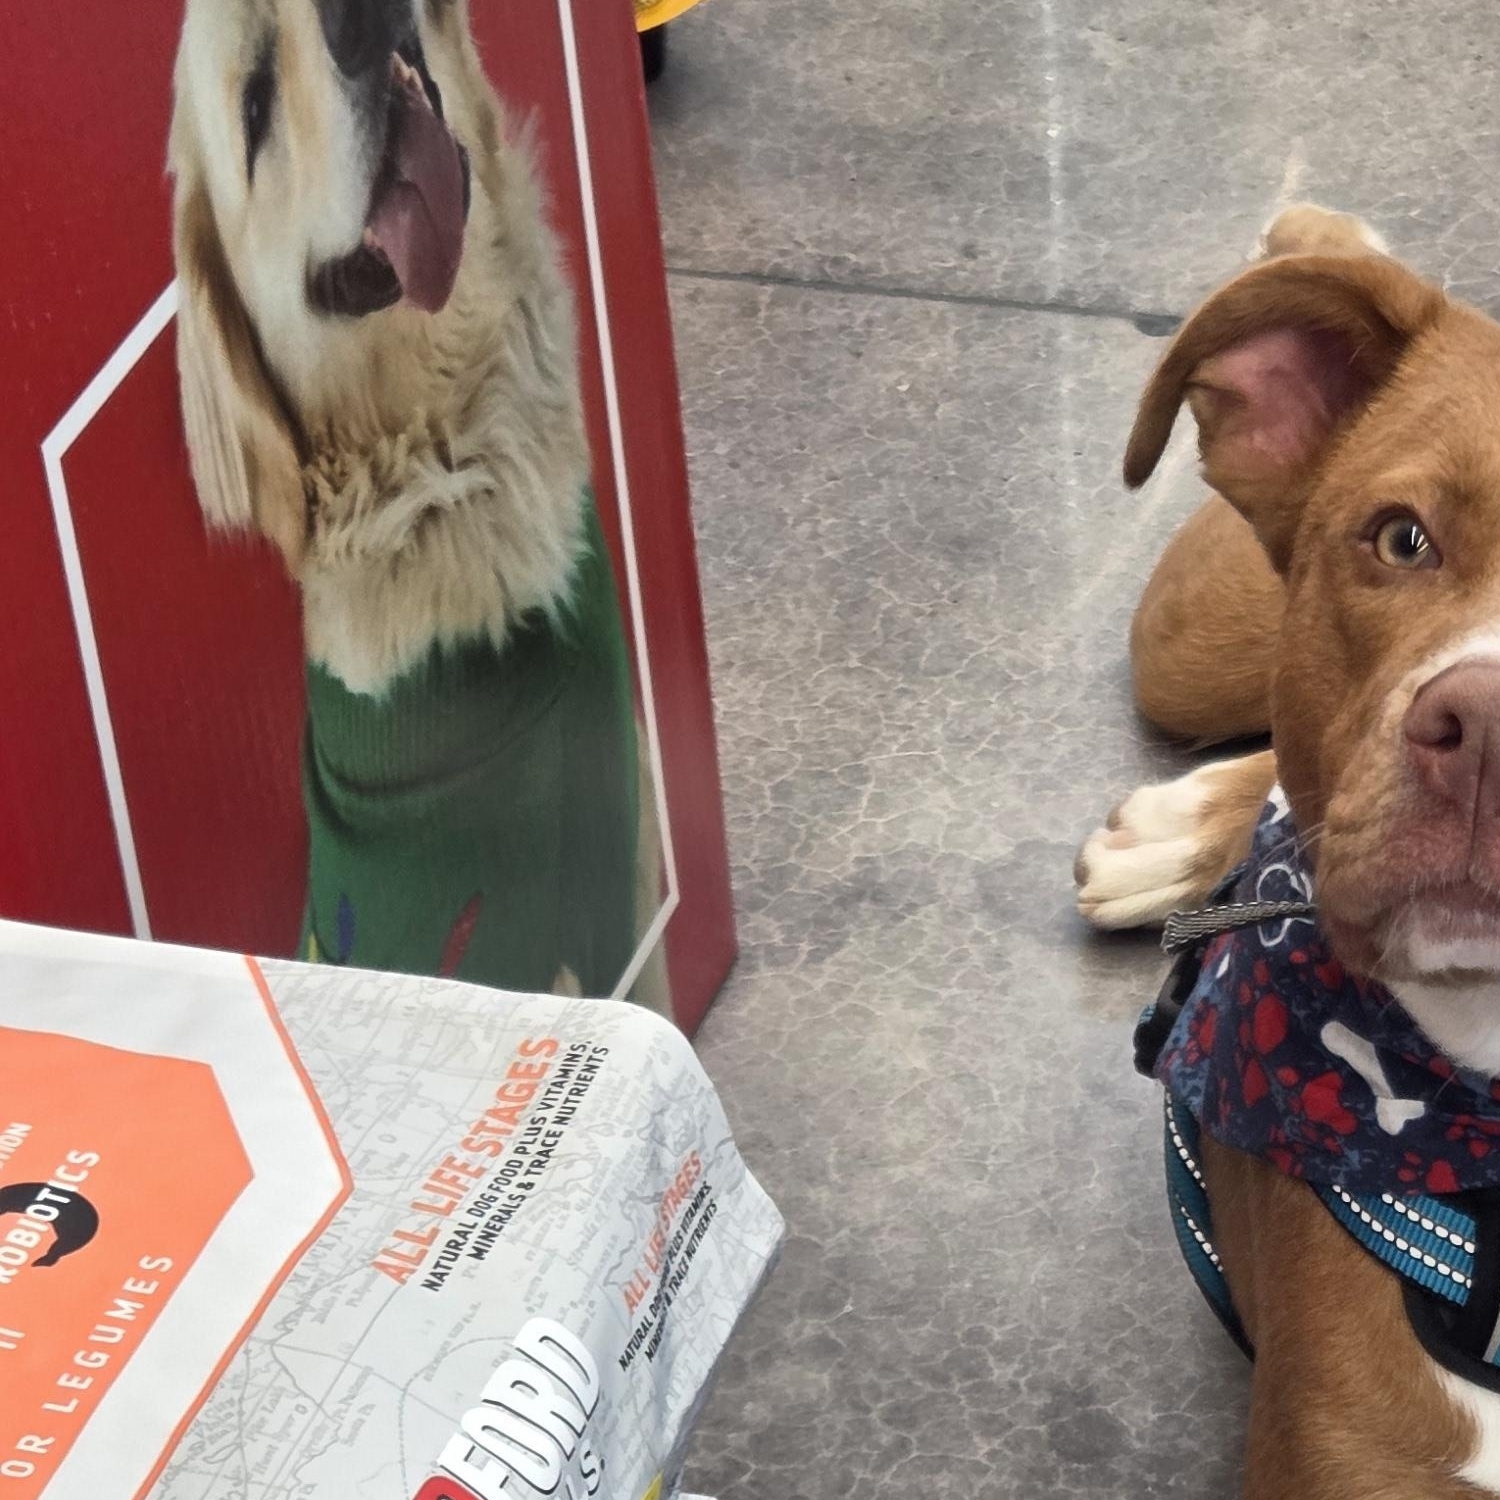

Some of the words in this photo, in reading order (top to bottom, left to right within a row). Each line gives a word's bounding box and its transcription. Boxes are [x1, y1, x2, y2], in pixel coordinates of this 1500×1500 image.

[552, 1046, 609, 1126] NUTRIENTS
[370, 1224, 441, 1286] ALL
[410, 1153, 487, 1217] LIFE
[459, 1036, 560, 1159] STAGES
[421, 1221, 477, 1291] NATURAL
[467, 1192, 498, 1218] DOG
[488, 1158, 524, 1194] FOOD
[513, 1116, 547, 1155] PLUS
[536, 1041, 592, 1114] VITAMINS,
[525, 1129, 564, 1177] TRACE
[516, 1181, 536, 1191] &
[467, 1193, 526, 1261] MINERALS
[687, 1199, 718, 1260] NUTRIENTS
[623, 1268, 651, 1317] ALL
[0, 1434, 56, 1478] OR
[42, 1254, 174, 1413] LEGUMES
[618, 1315, 654, 1372] NATURAL
